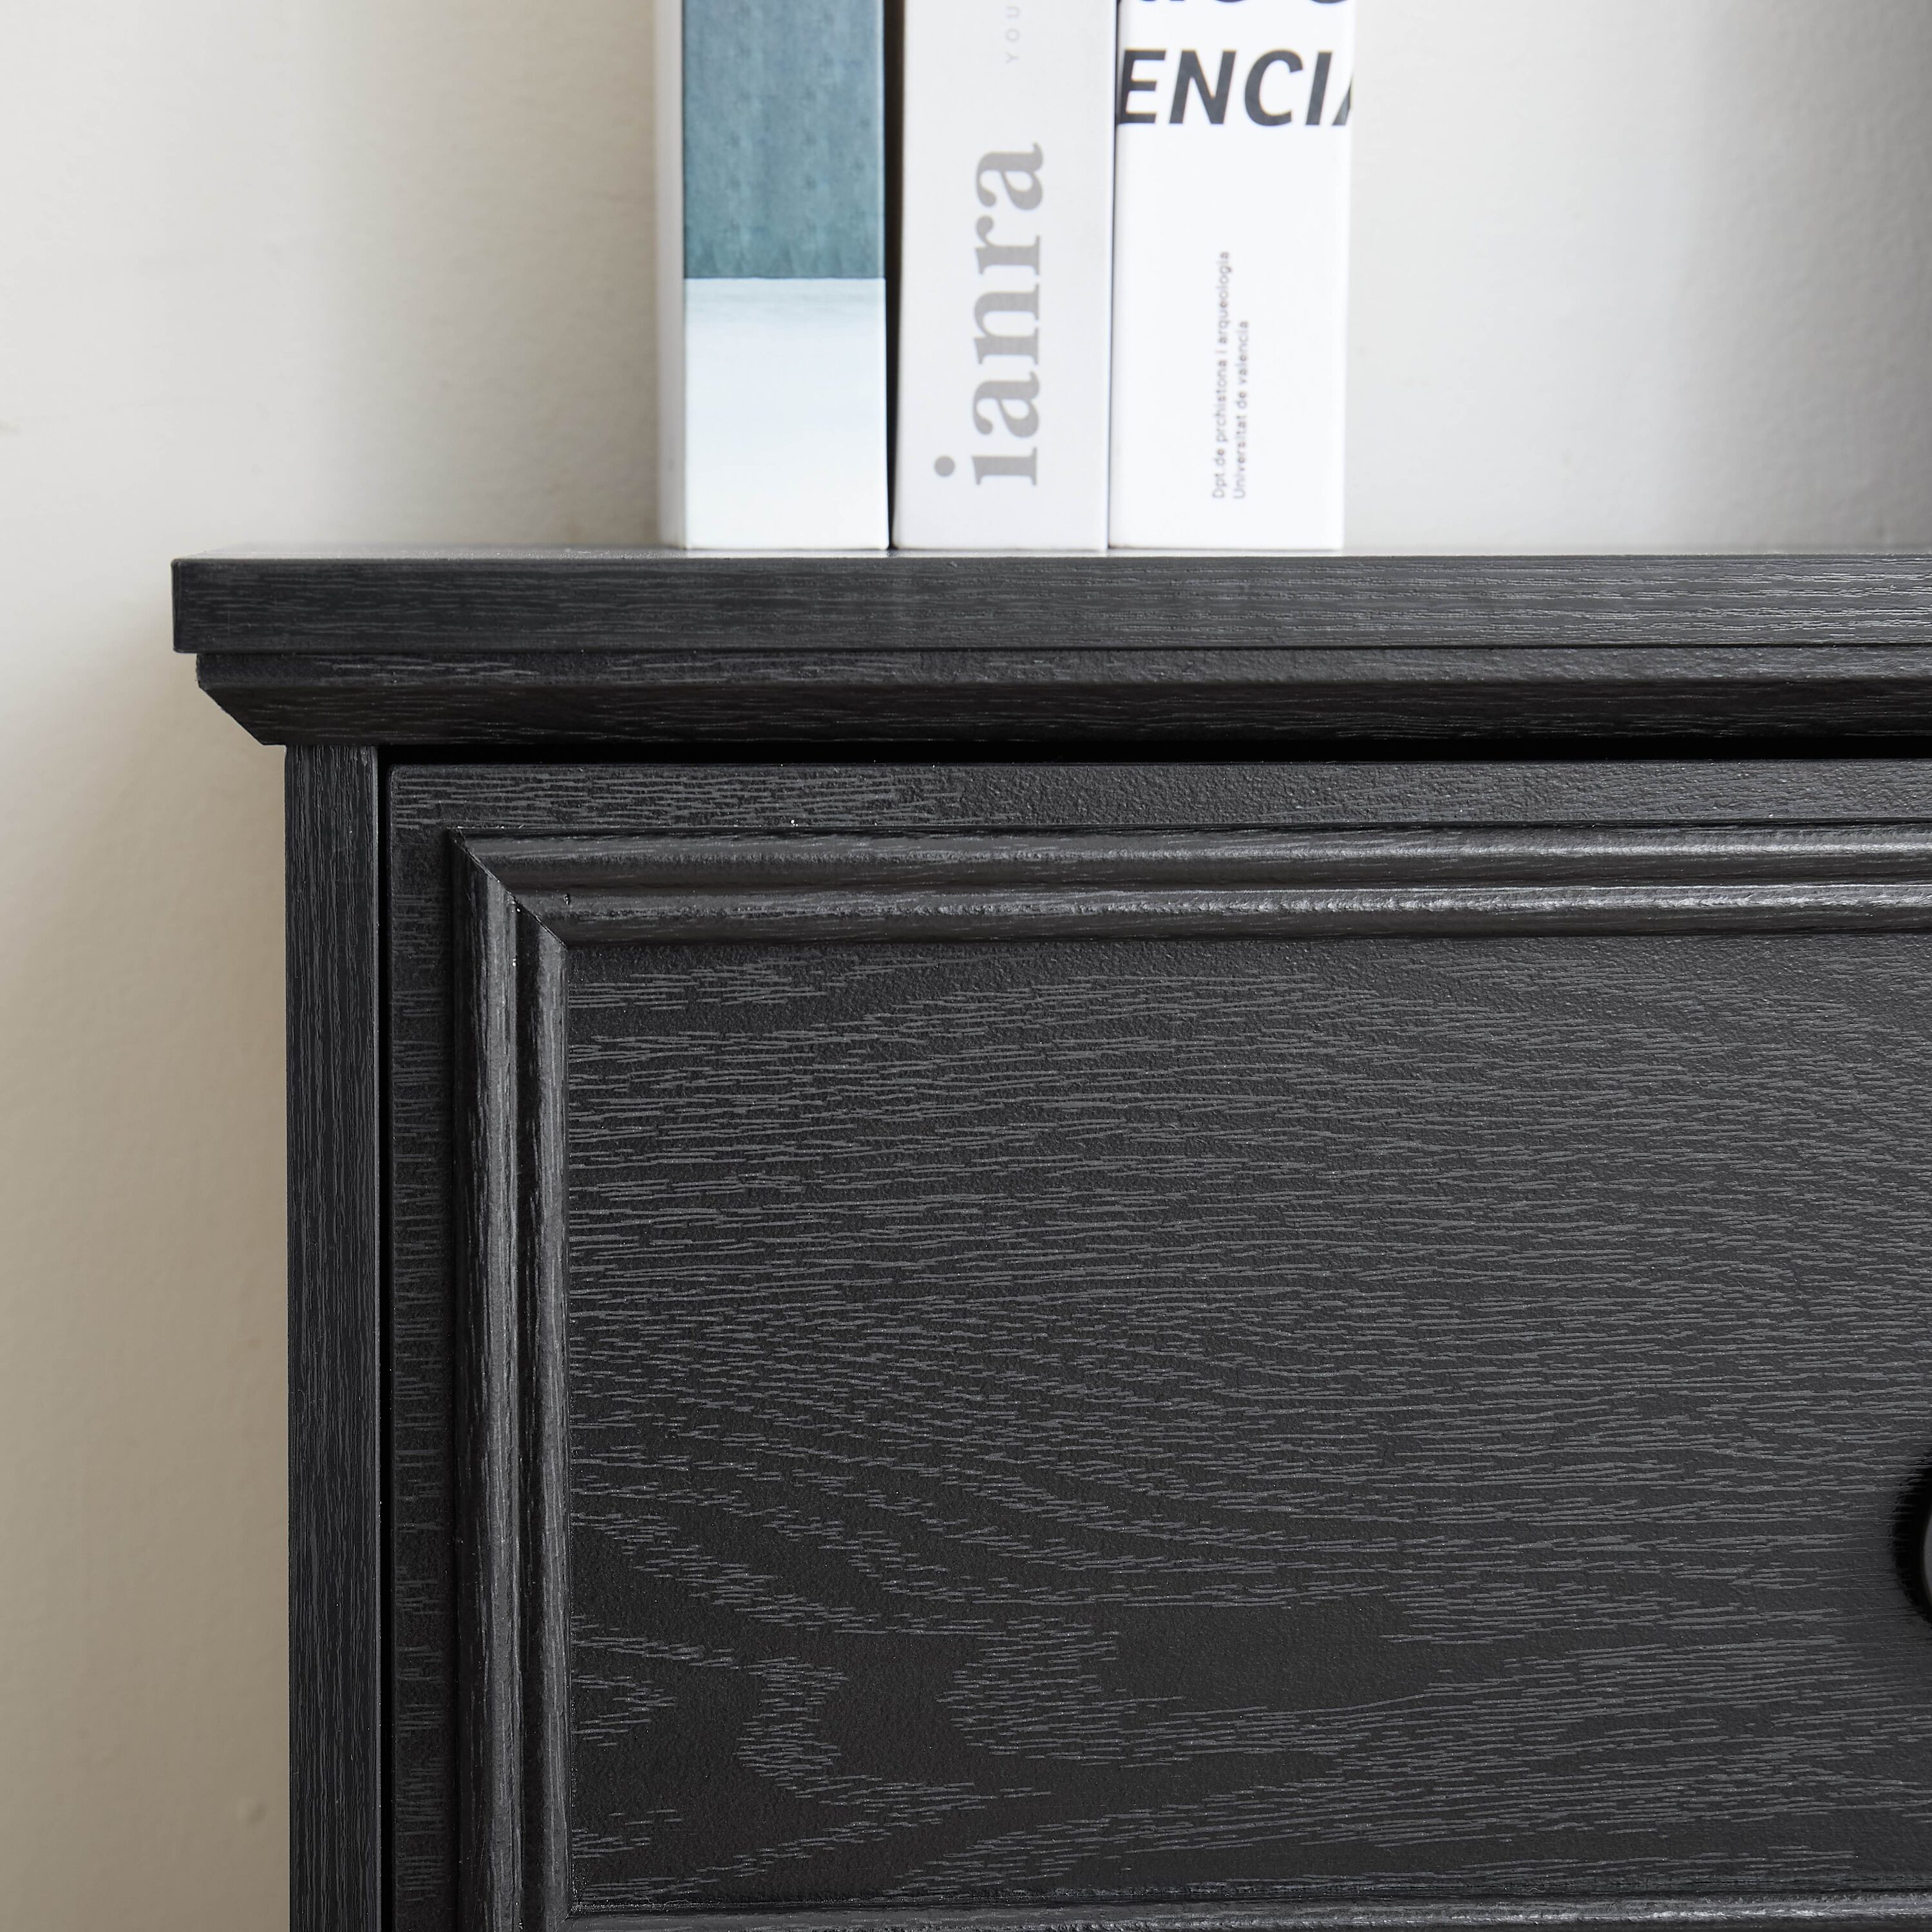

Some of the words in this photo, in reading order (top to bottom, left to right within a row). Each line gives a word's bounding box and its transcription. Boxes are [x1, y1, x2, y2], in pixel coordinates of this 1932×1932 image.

[934, 142, 1044, 486] ianra
[1235, 321, 1249, 386] valencia
[1235, 390, 1248, 409] de
[1213, 448, 1227, 467] de
[1233, 414, 1247, 500] Universitat
